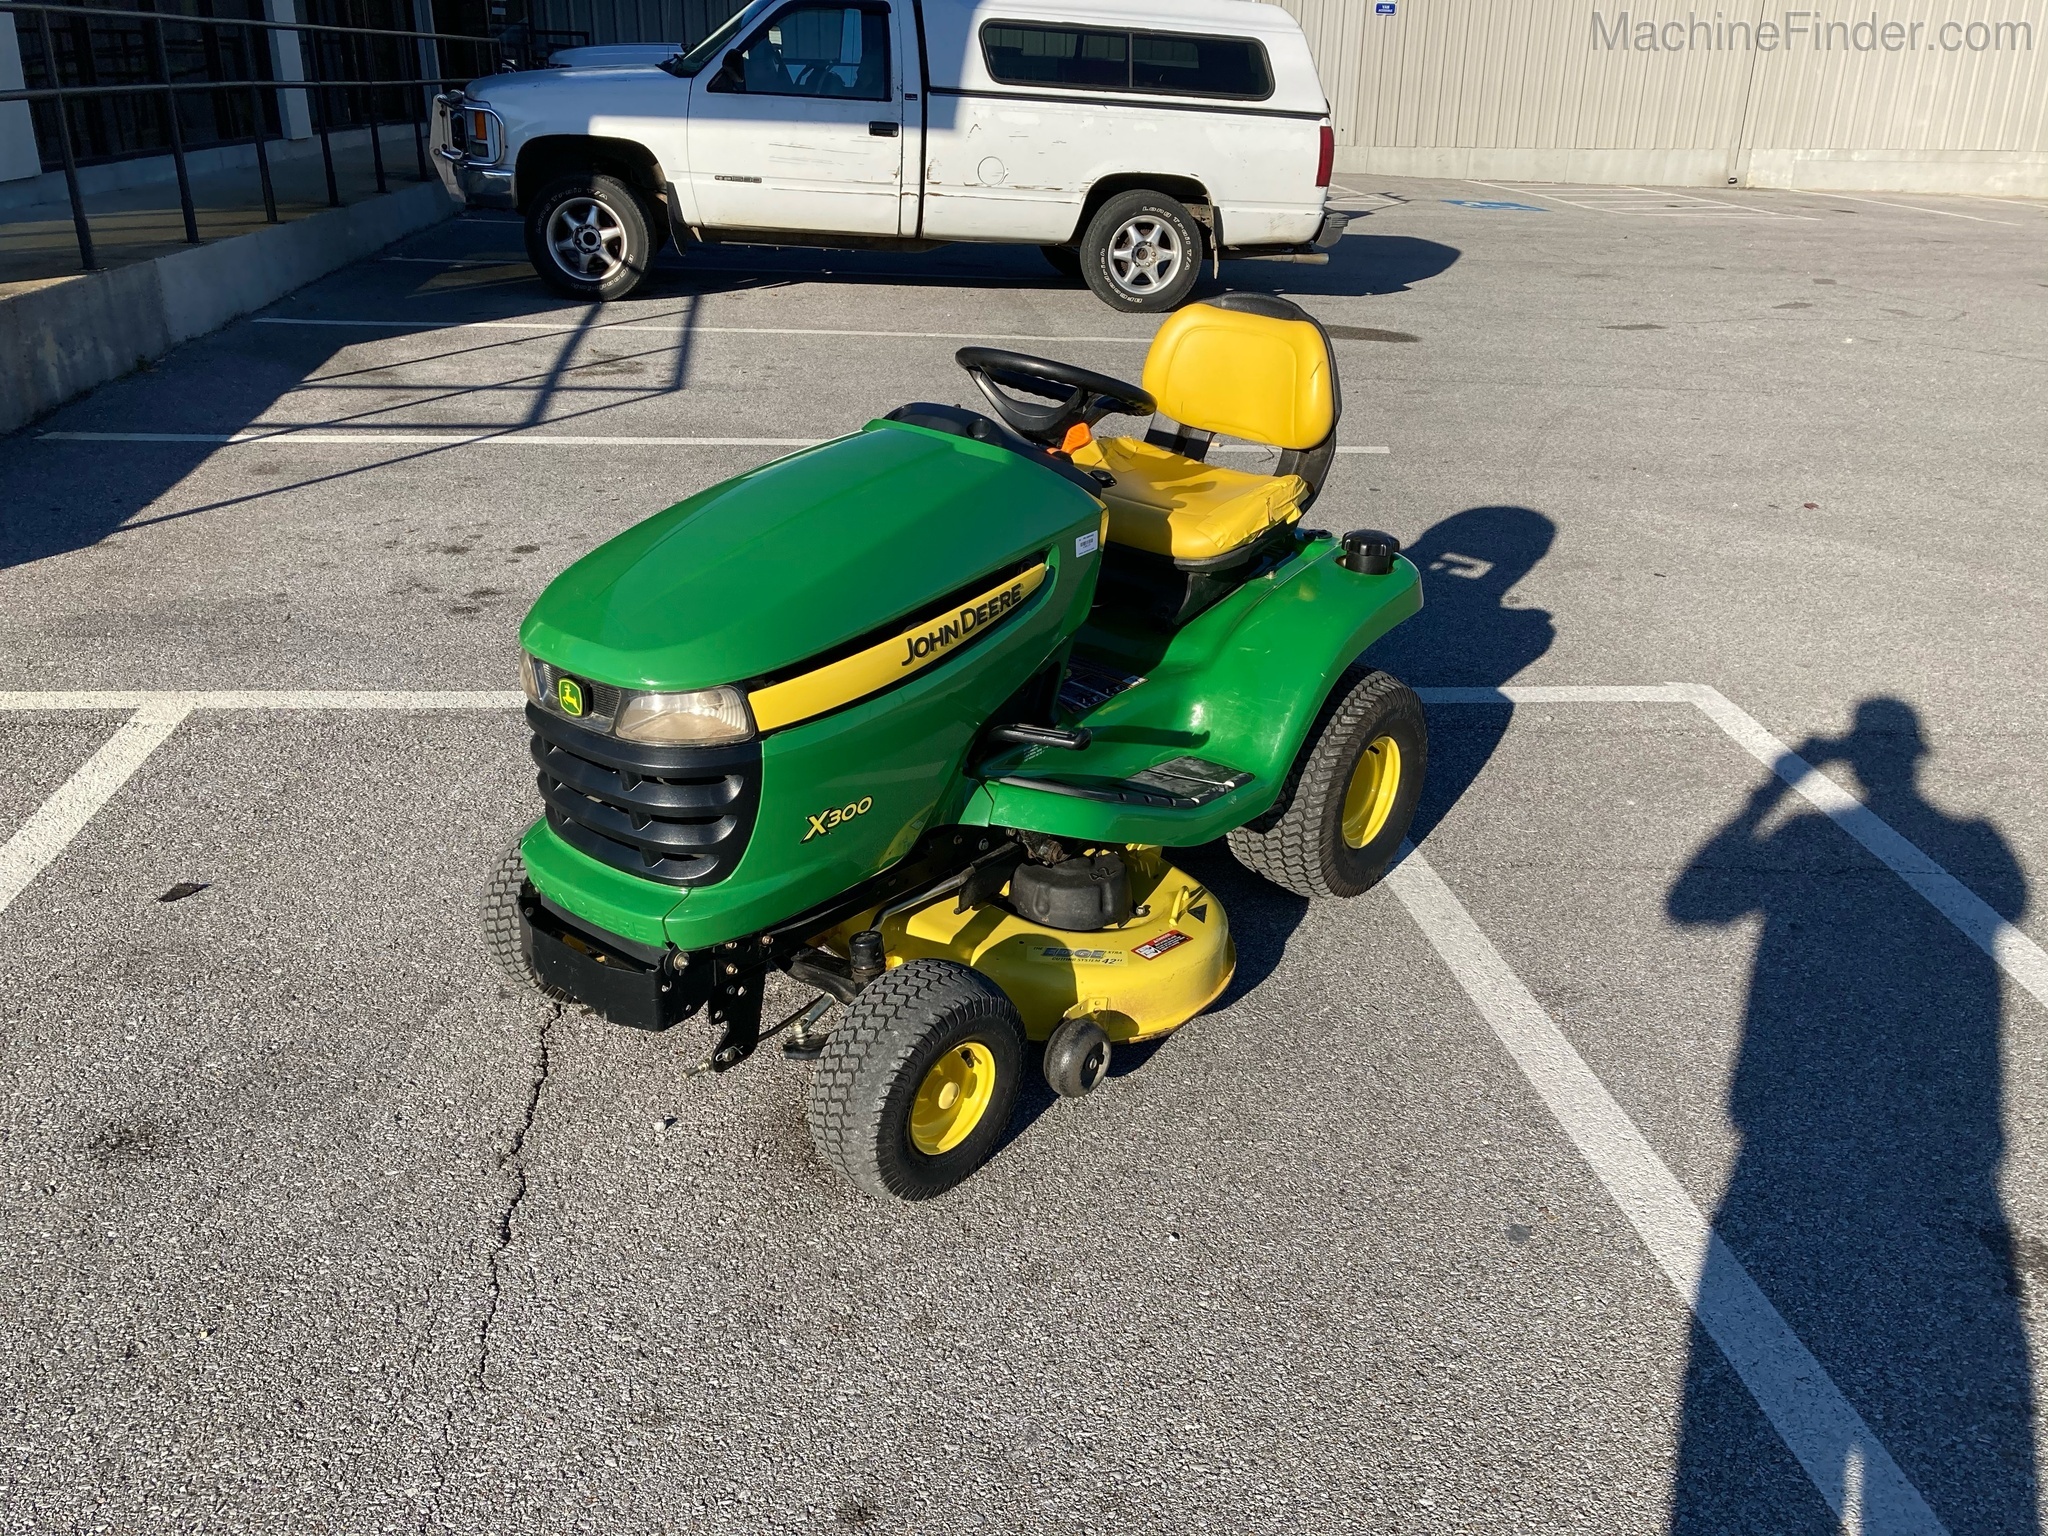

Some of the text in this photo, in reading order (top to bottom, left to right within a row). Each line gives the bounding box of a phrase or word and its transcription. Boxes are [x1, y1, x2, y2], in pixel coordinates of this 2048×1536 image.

[901, 582, 1023, 667] JOHN DEERE
[802, 795, 874, 842] X300
[1089, 866, 1117, 881] 42
[1041, 947, 1107, 959] EDGE
